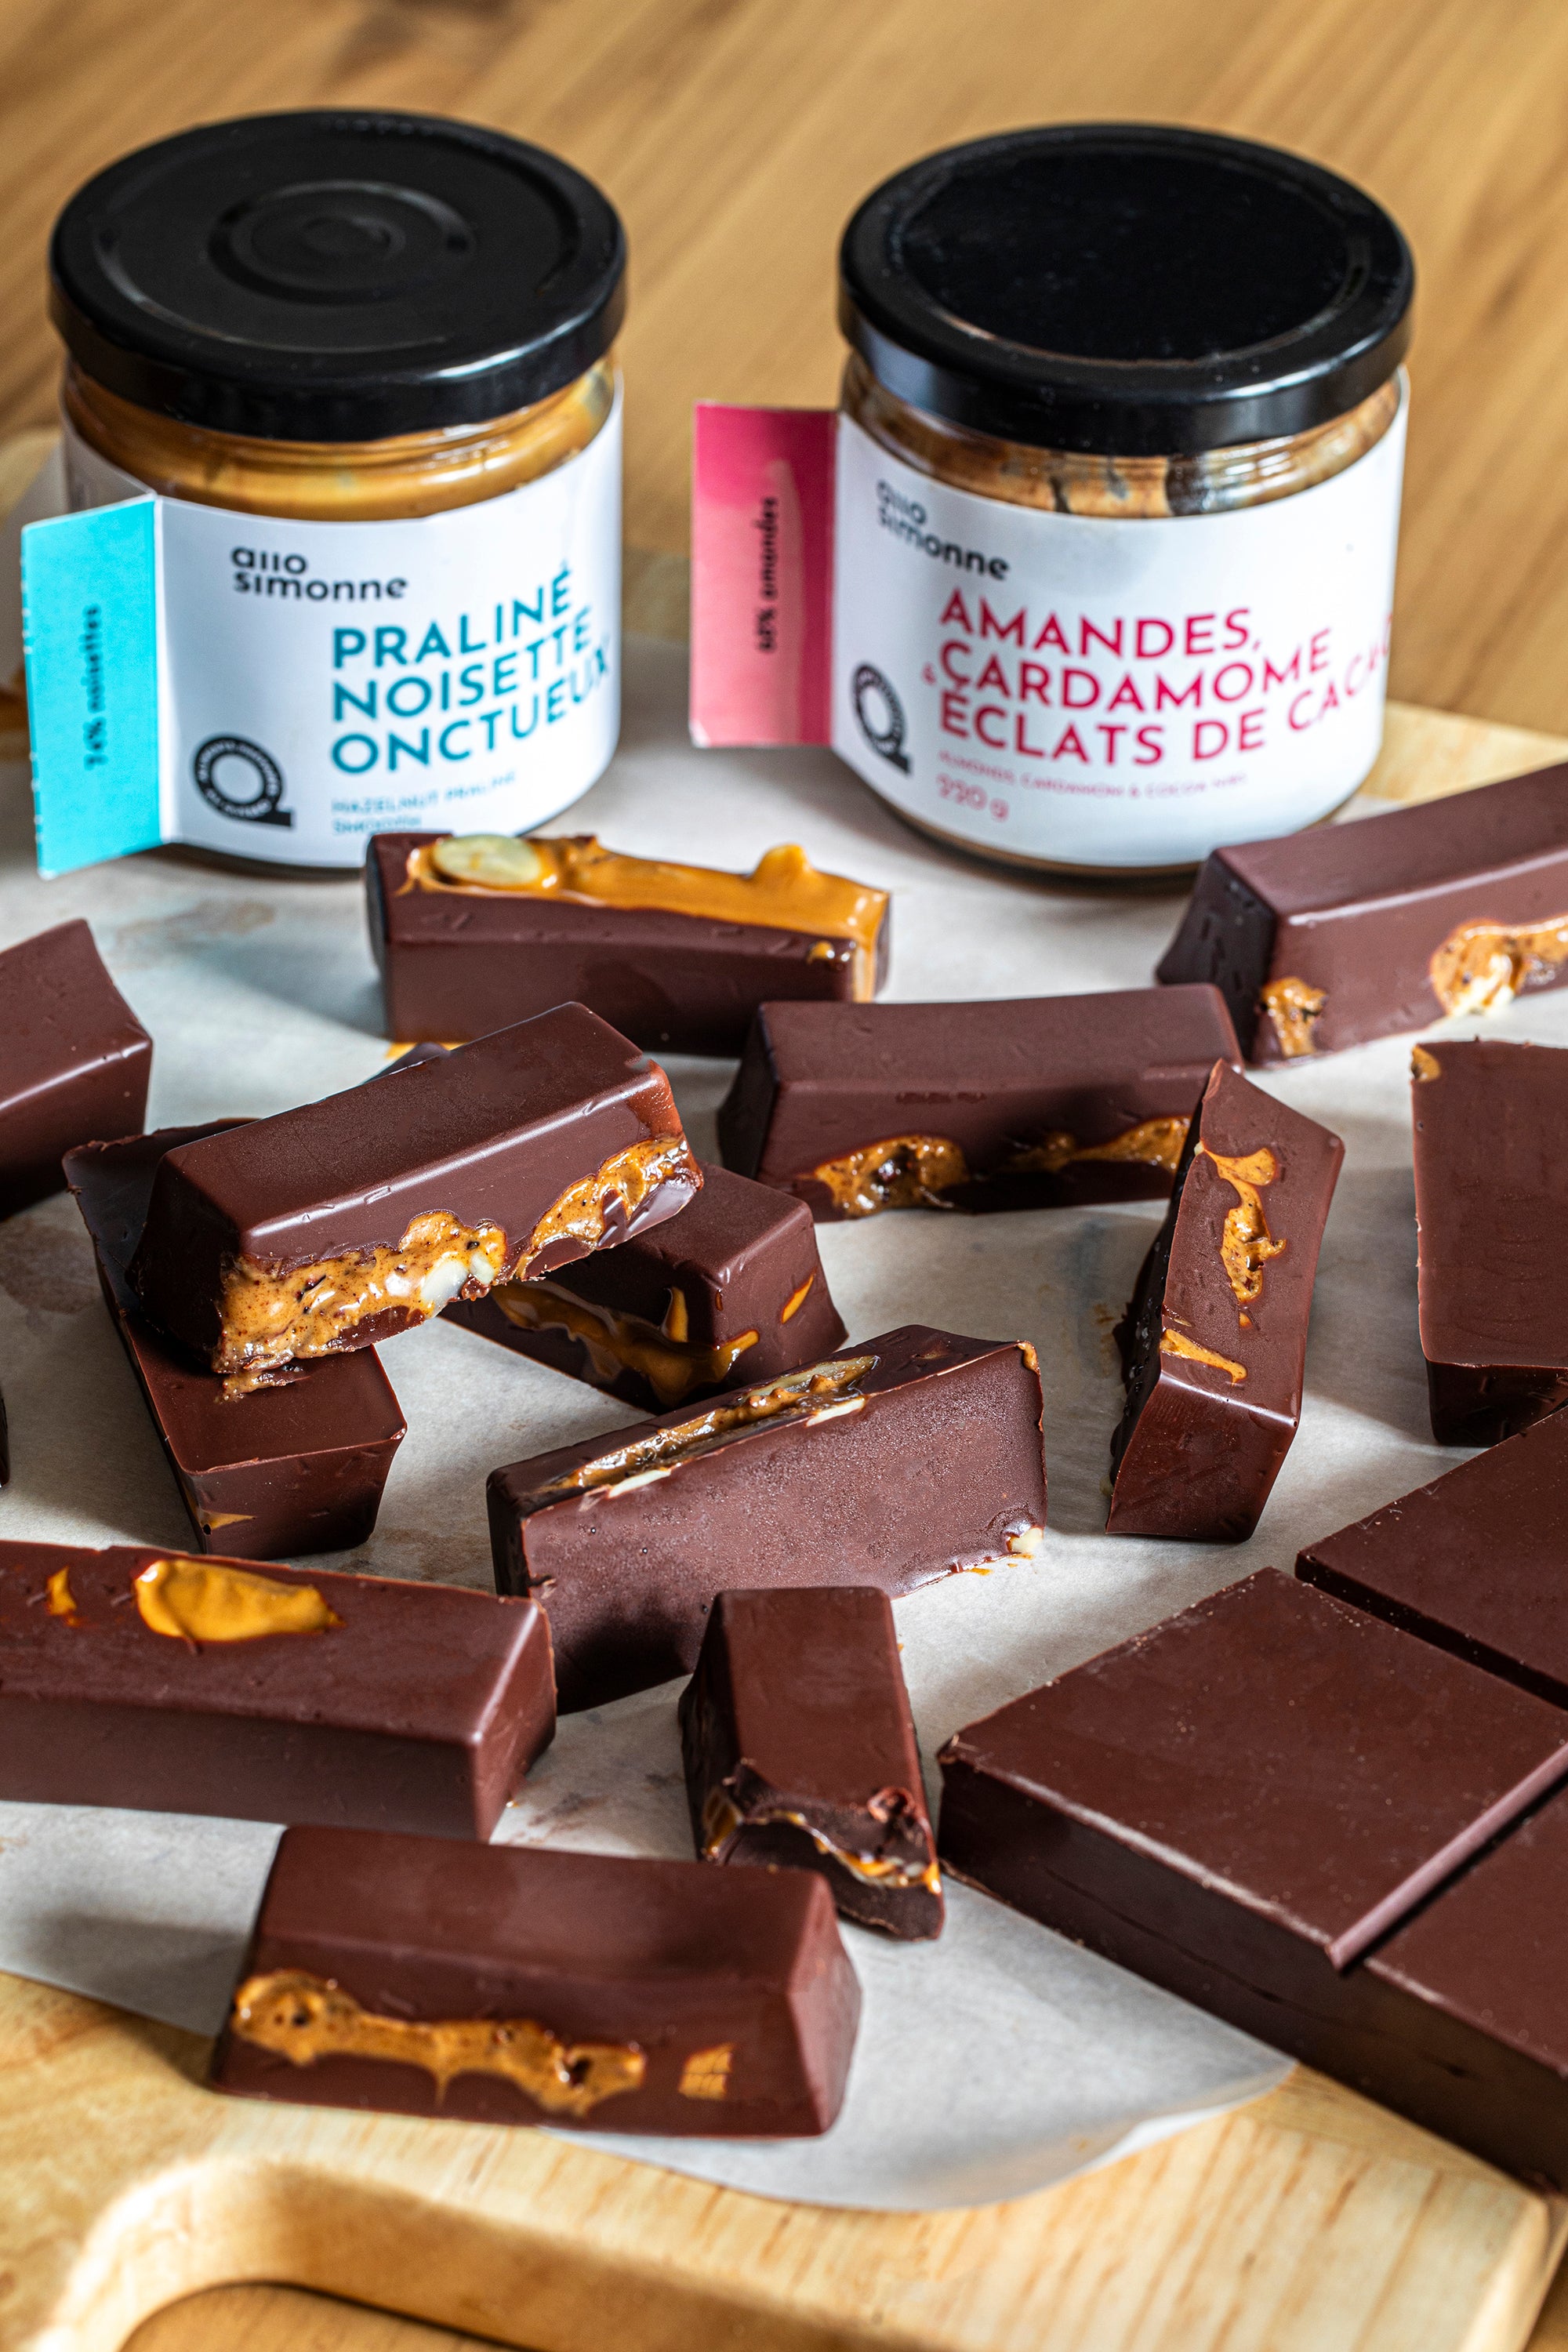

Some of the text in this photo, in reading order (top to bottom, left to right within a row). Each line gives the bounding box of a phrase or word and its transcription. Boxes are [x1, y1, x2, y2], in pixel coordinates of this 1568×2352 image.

[234, 572, 408, 602] simonne
[753, 497, 777, 601] amandes
[879, 505, 1009, 581] simonne
[82, 603, 105, 713] noisettes
[333, 560, 570, 669] PRALINÉ
[940, 588, 1261, 657] AMANDES,
[332, 635, 608, 774] ONCTUEUX
[333, 606, 590, 721] NOISETTE
[940, 629, 1330, 713] CARDAMOME
[941, 680, 1163, 765] ÉCLATS
[1193, 708, 1265, 760] DE
